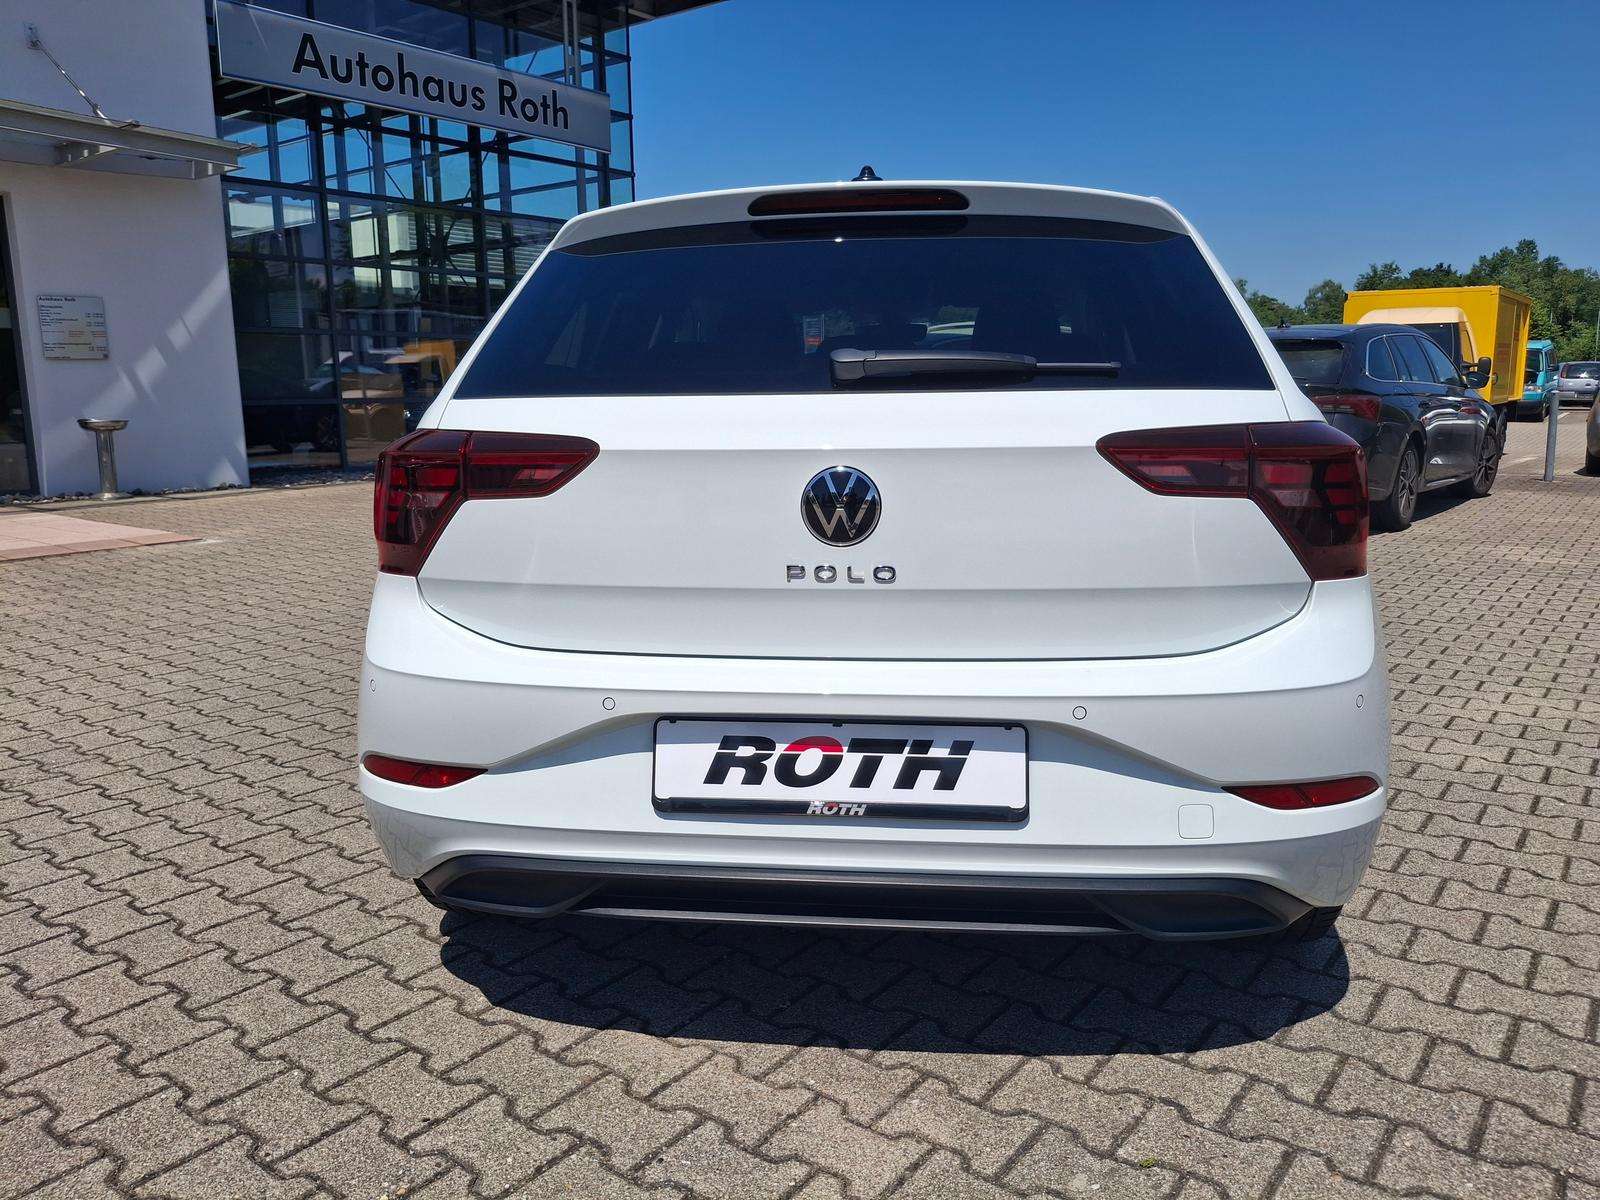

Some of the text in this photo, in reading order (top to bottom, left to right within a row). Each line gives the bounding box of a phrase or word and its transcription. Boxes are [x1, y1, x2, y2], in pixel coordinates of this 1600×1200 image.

[292, 33, 569, 130] Autohaus Roth
[786, 564, 897, 584] POLO
[703, 735, 975, 791] ROTH
[807, 800, 867, 817] ROTH
